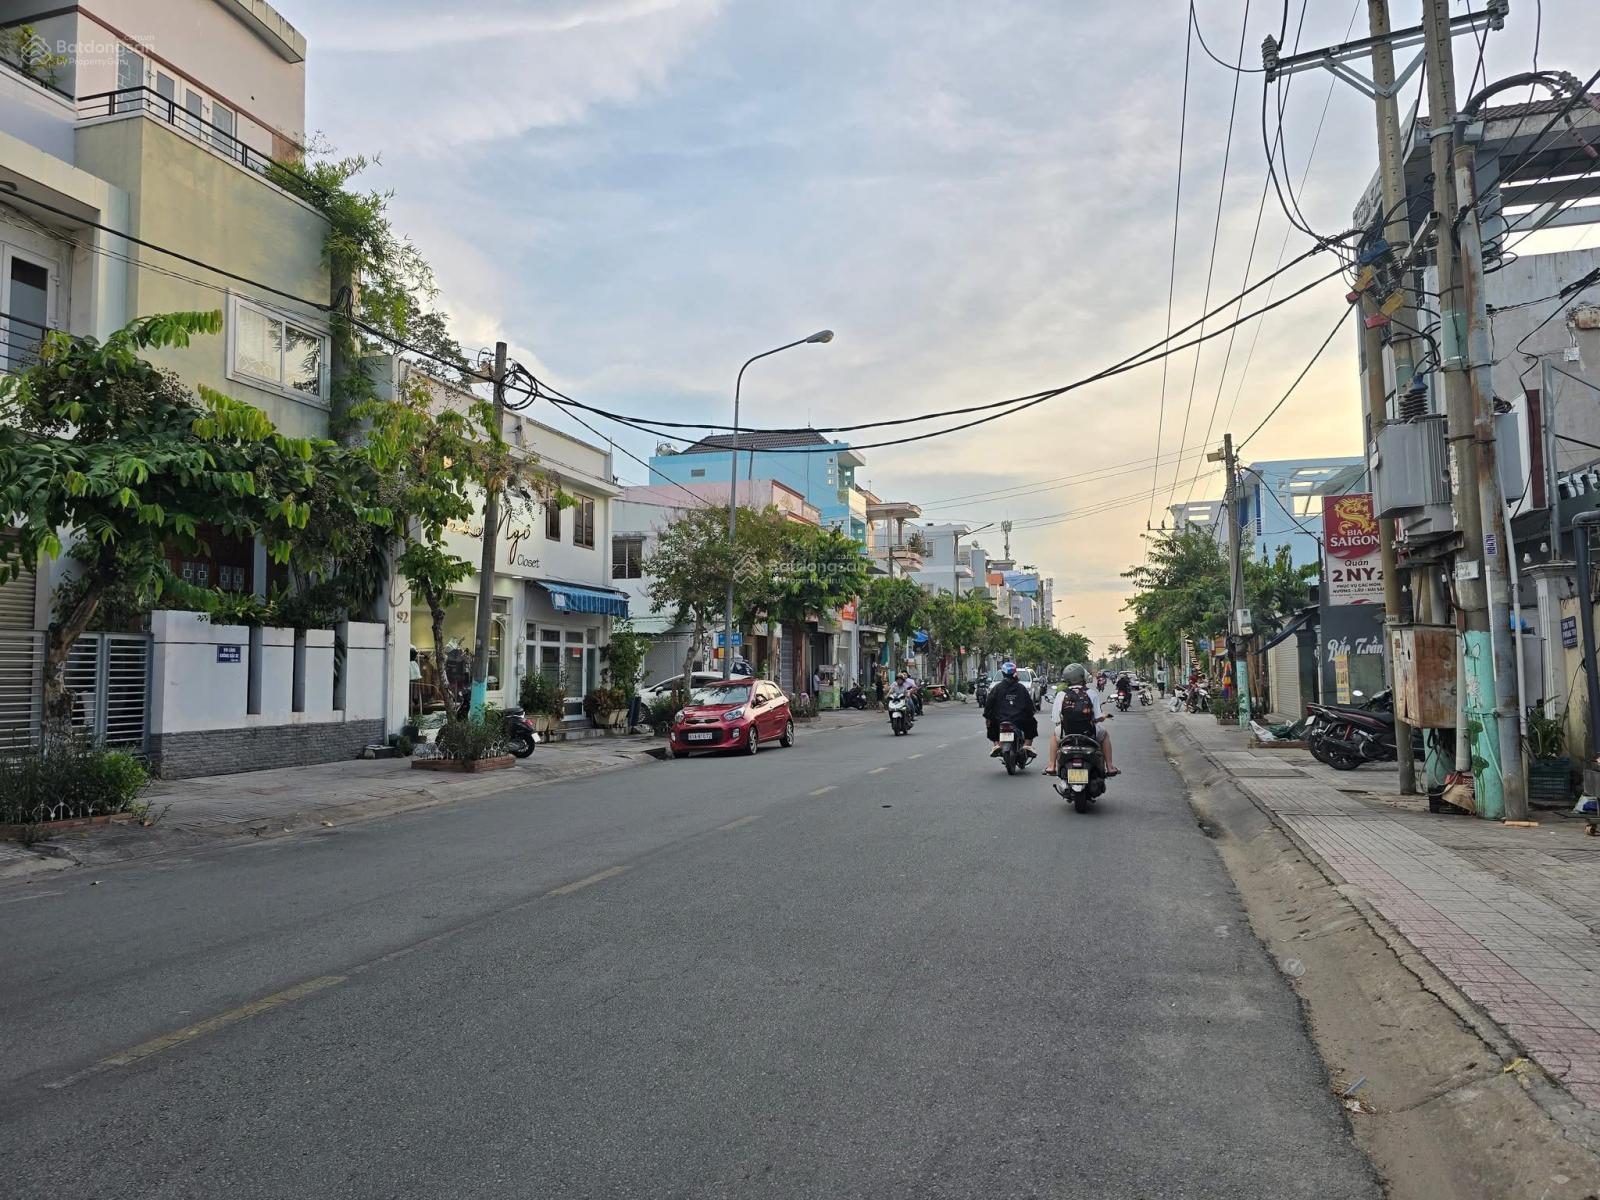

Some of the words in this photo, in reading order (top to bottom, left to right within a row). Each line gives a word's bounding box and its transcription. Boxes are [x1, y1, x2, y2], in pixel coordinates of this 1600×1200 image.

[1330, 535, 1380, 547] SAIGON
[518, 554, 541, 569] Closet
[397, 611, 409, 623] 92
